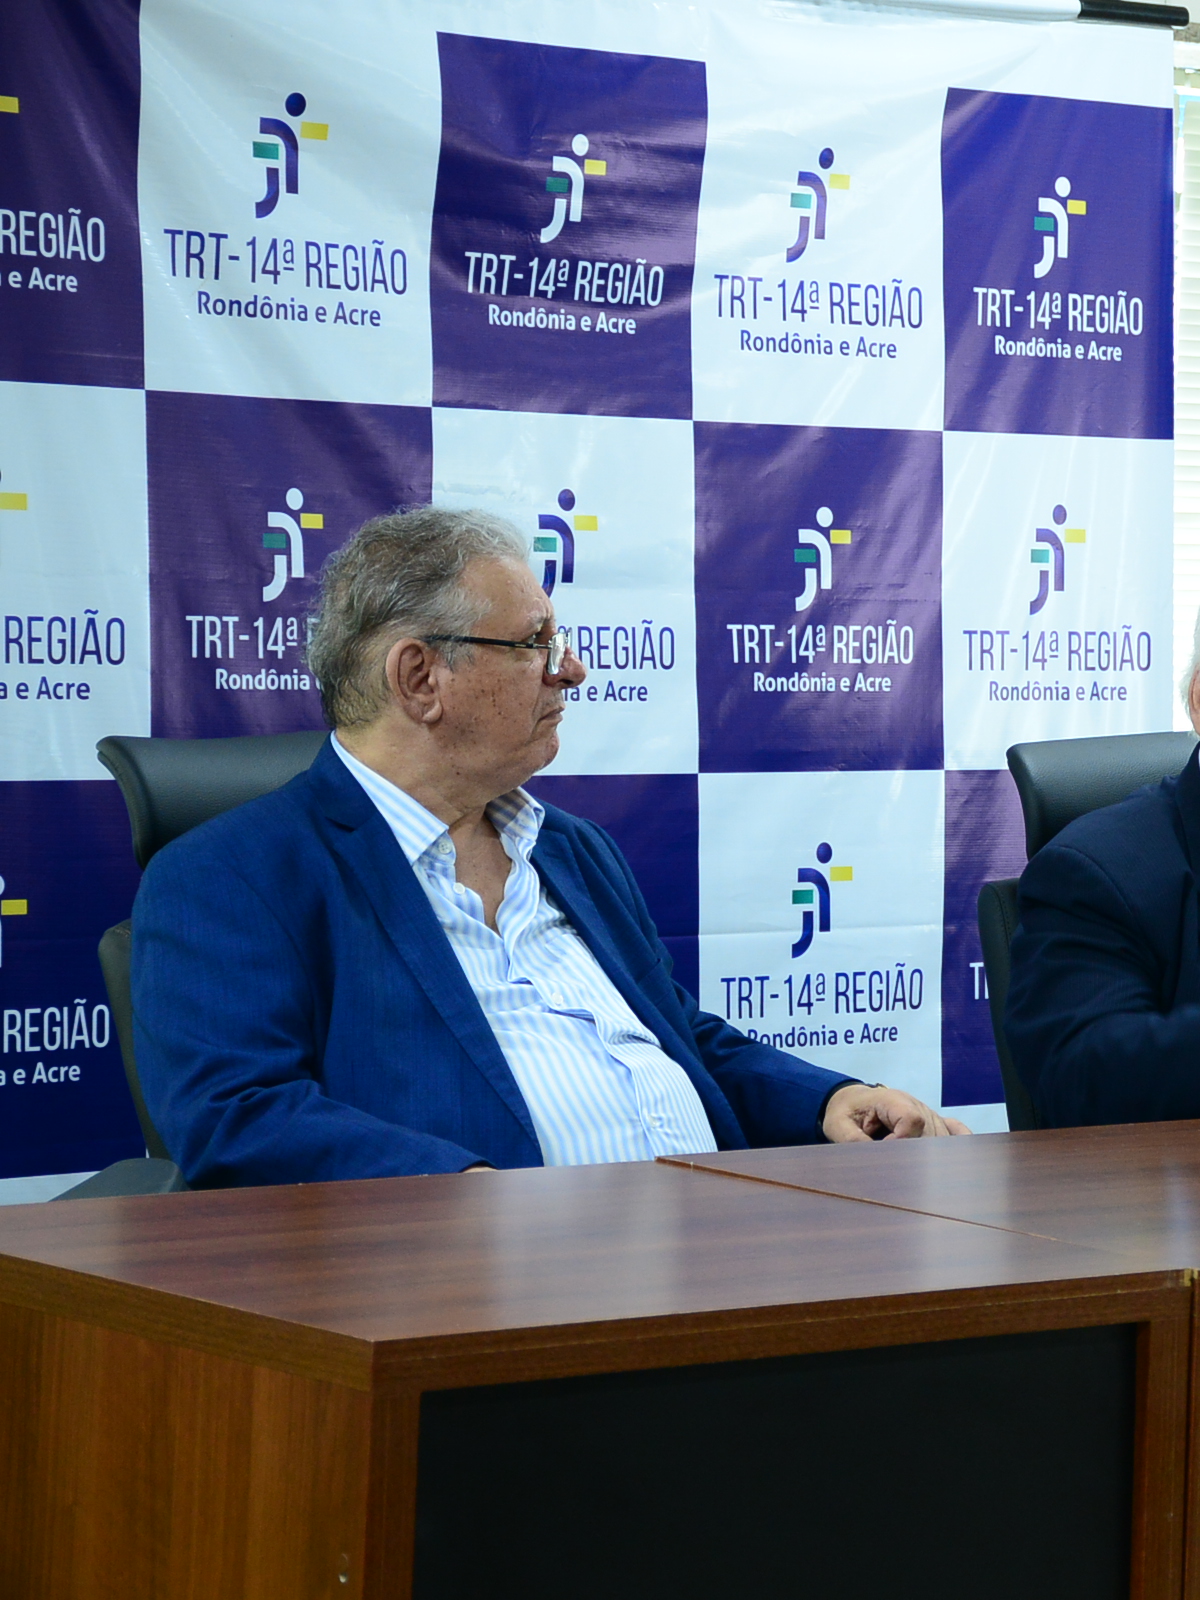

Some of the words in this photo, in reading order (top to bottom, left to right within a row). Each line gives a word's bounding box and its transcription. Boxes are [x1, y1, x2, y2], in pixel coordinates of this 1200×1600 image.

[0, 208, 106, 263] REGIÃO
[8, 271, 23, 289] e
[28, 266, 78, 293] Acre
[304, 239, 408, 296] REGIÃO
[573, 258, 665, 307] REGIÃO
[197, 290, 309, 322] Rondônia
[315, 306, 327, 323] e
[333, 301, 381, 328] Acre
[488, 303, 576, 331] Rondônia
[580, 315, 592, 332] e
[595, 311, 637, 335] Acre
[828, 278, 924, 330] REGIÃO
[1068, 290, 1144, 336] REGIÃO
[740, 329, 834, 356] Rondônia
[839, 340, 850, 357] e
[855, 336, 898, 359] Acre
[994, 334, 1073, 359] Rondônia
[1074, 344, 1085, 360] e
[1087, 340, 1123, 362] Acre
[4, 608, 126, 666] REGIÃO
[577, 619, 675, 671] REGIÃO
[833, 619, 914, 665] REGIÃO
[1067, 624, 1152, 672] REGIÃO
[15, 682, 30, 700] e
[36, 676, 91, 701] Acre
[215, 668, 311, 691] Rondônia
[586, 685, 598, 702] e
[603, 680, 648, 702] Acre
[753, 671, 836, 692] Rondônia
[839, 676, 851, 692] e
[853, 672, 892, 693] Acre
[989, 680, 1070, 702] Rondônia
[1075, 686, 1086, 701] e
[1089, 680, 1128, 702] Acre
[834, 962, 924, 1014] REGIÃO
[3, 998, 110, 1054] REGIÃO
[843, 1028, 855, 1044] e
[859, 1022, 899, 1044] Acre
[12, 1068, 26, 1085] e
[31, 1061, 81, 1084] Acre
